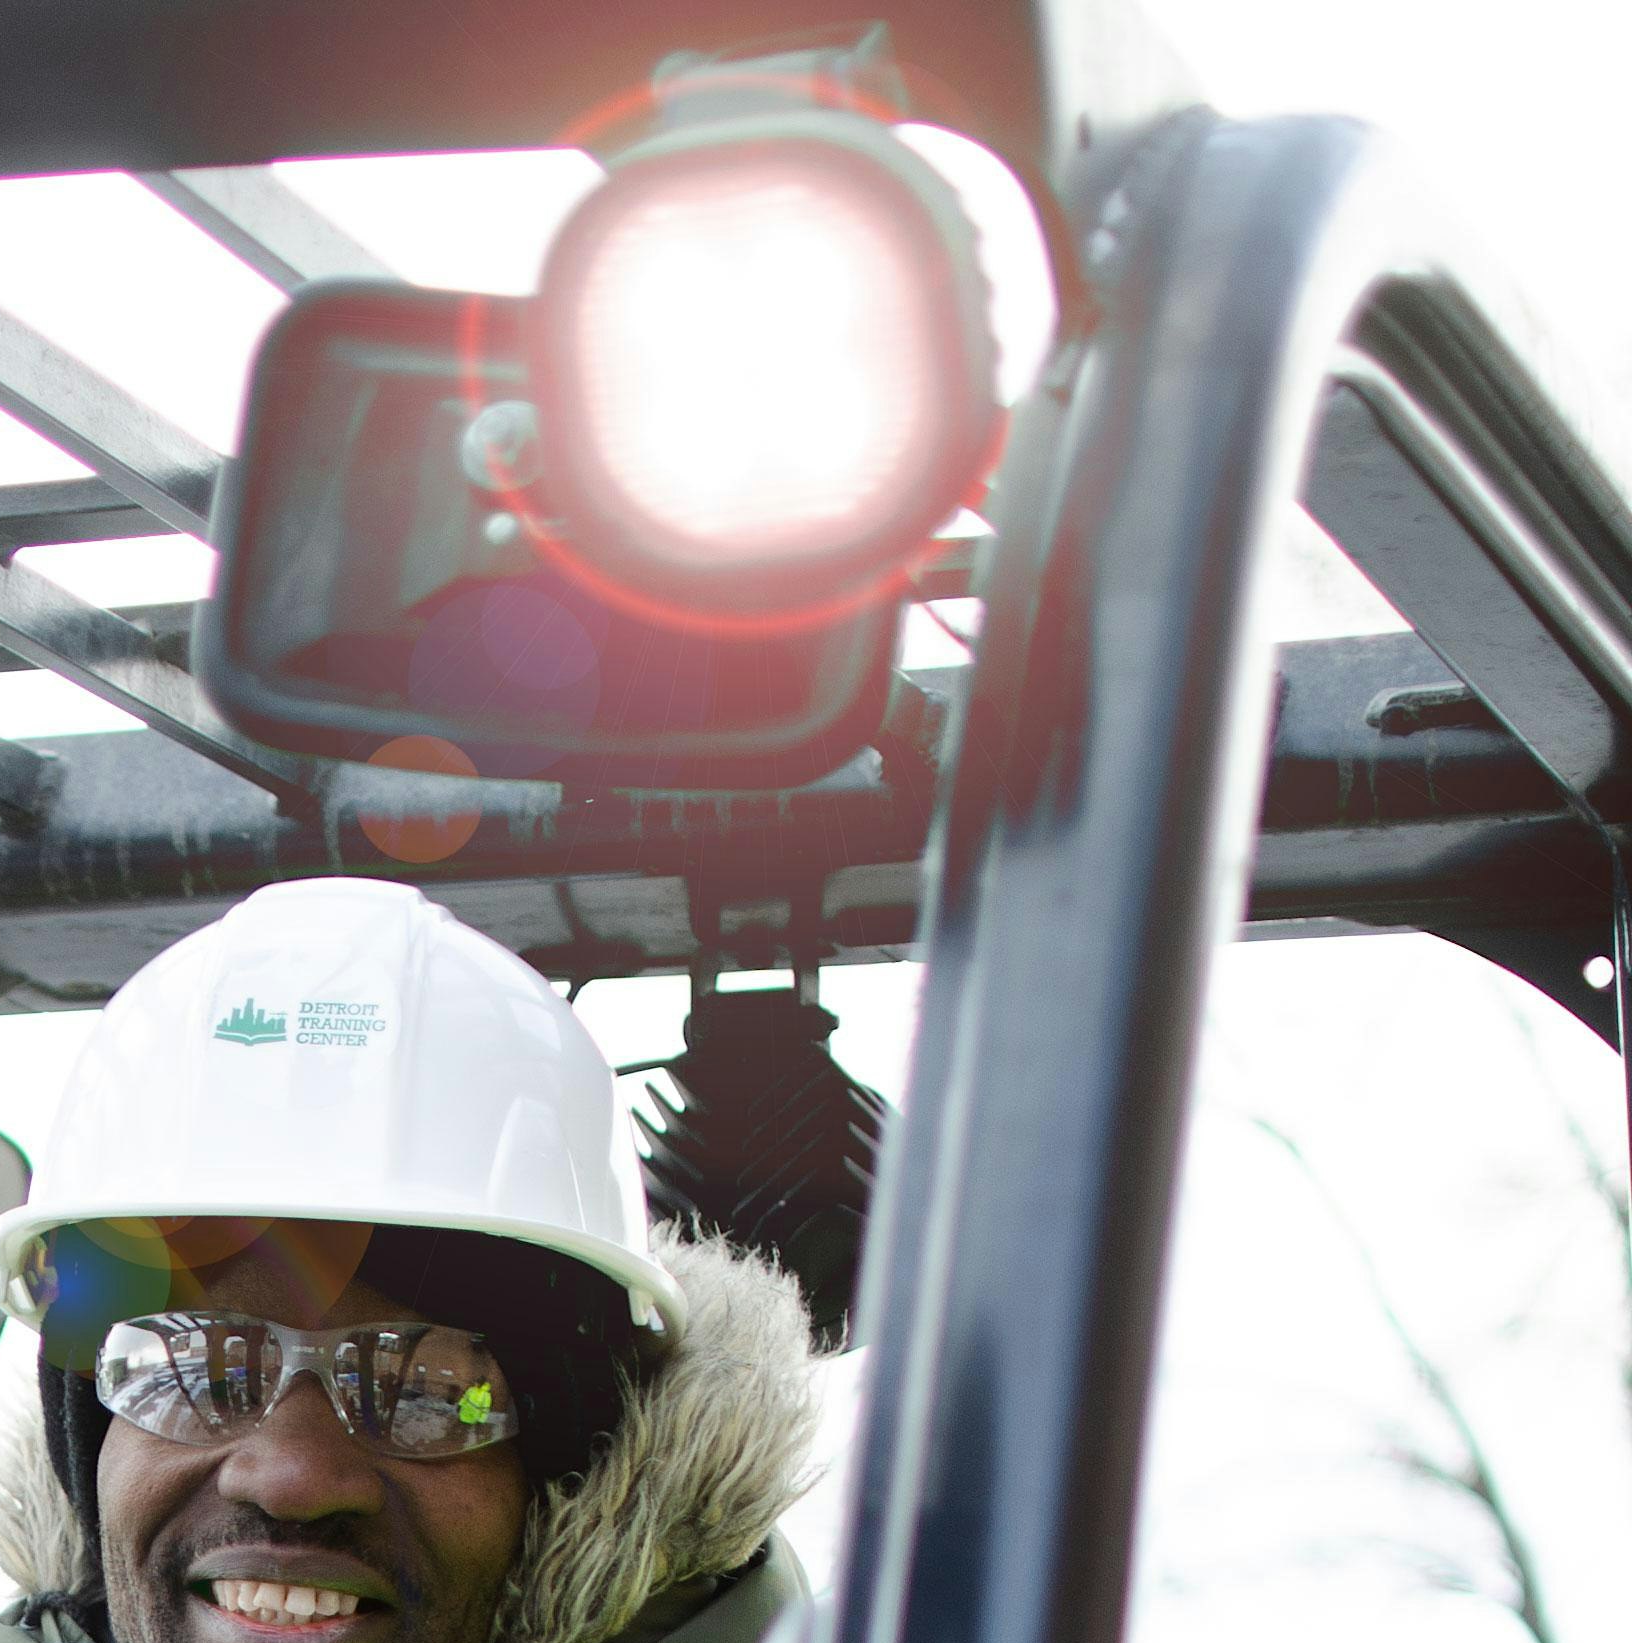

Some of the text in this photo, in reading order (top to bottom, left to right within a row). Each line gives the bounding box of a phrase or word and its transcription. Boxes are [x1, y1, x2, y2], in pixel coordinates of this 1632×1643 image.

[299, 1001, 379, 1017] DETROIT
[297, 1016, 386, 1032] TRAINING
[295, 1031, 368, 1047] CENTER
